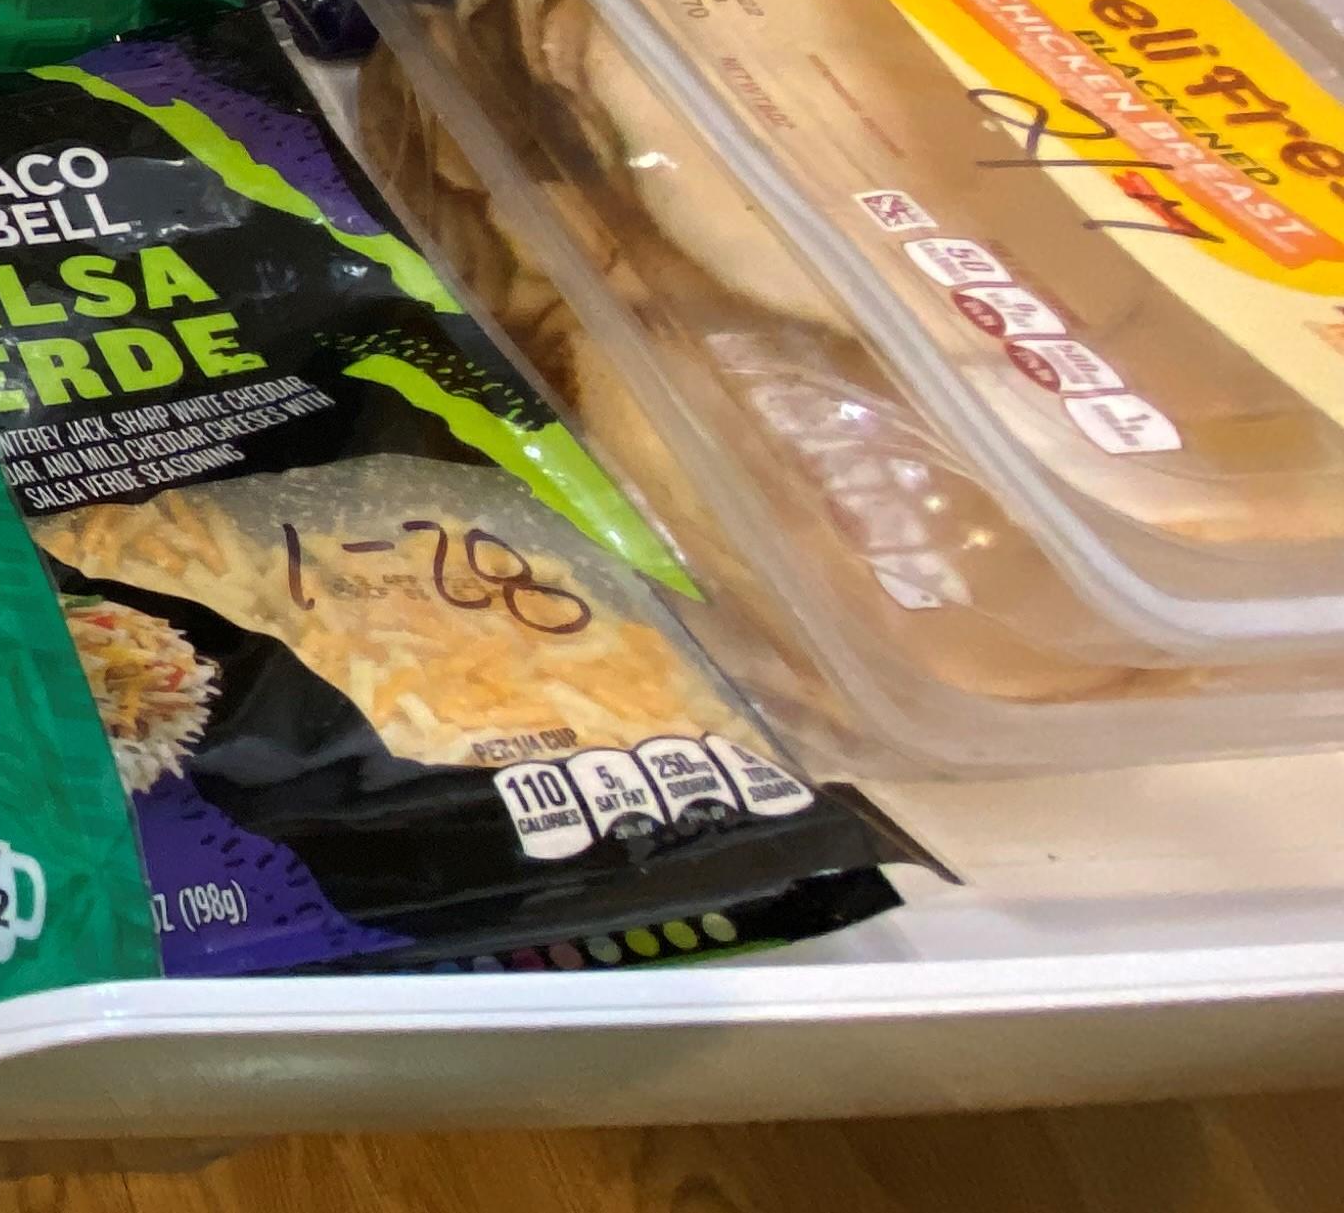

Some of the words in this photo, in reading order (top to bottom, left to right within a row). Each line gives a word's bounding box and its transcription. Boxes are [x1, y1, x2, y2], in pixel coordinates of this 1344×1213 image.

[1069, 29, 1281, 186] BLACKENED
[1137, 121, 1318, 238] BREAST
[42, 450, 86, 483] AND
[78, 442, 132, 476] MILD
[126, 423, 215, 462] CHEDDAR
[206, 404, 289, 444] CHEESES
[280, 389, 337, 419] WITH
[67, 415, 118, 446] JACK,
[113, 404, 171, 438] SHARP
[168, 393, 232, 425] WHITE
[231, 375, 317, 413] CHEDDAR,
[24, 478, 87, 510] SALSA
[80, 464, 146, 501] VERDE
[141, 443, 247, 485] SEASONING
[280, 519, 594, 635] 1-28
[505, 769, 569, 814] 110
[517, 809, 582, 836] CALORIES
[594, 792, 622, 814] SAT
[621, 788, 648, 808] FAT
[178, 878, 248, 933] (198g)
